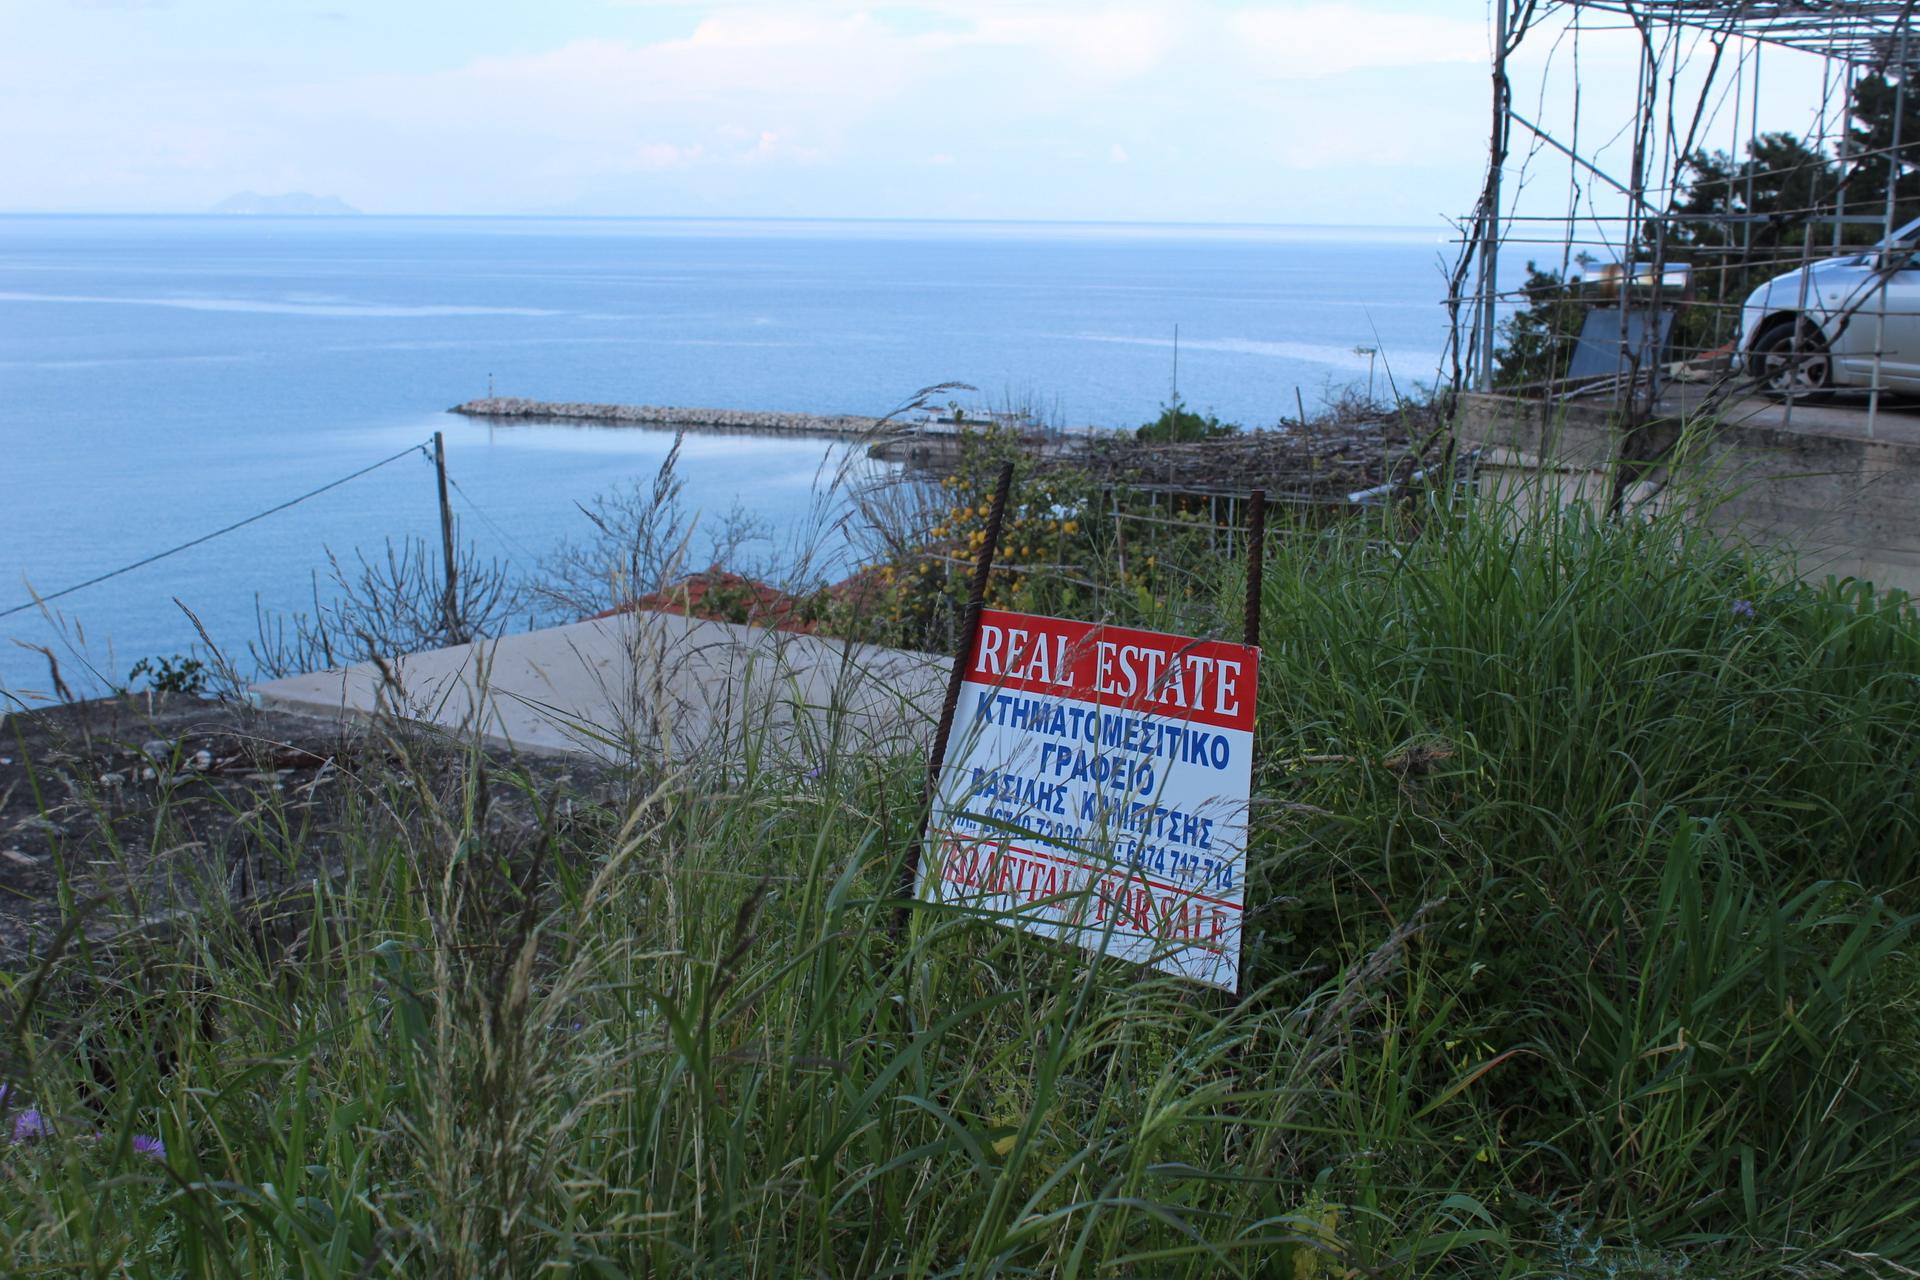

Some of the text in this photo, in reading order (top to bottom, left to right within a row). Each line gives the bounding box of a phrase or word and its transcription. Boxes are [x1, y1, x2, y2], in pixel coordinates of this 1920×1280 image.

[975, 624, 1242, 717] REAL ESTATE
[976, 691, 1230, 770] ΚΤΗΜΑΤΟΜΕΣΙΤΙΚΟ
[1040, 742, 1155, 796] ΓΡΑΦΕΙΟ
[1096, 879, 1153, 933] FOR
